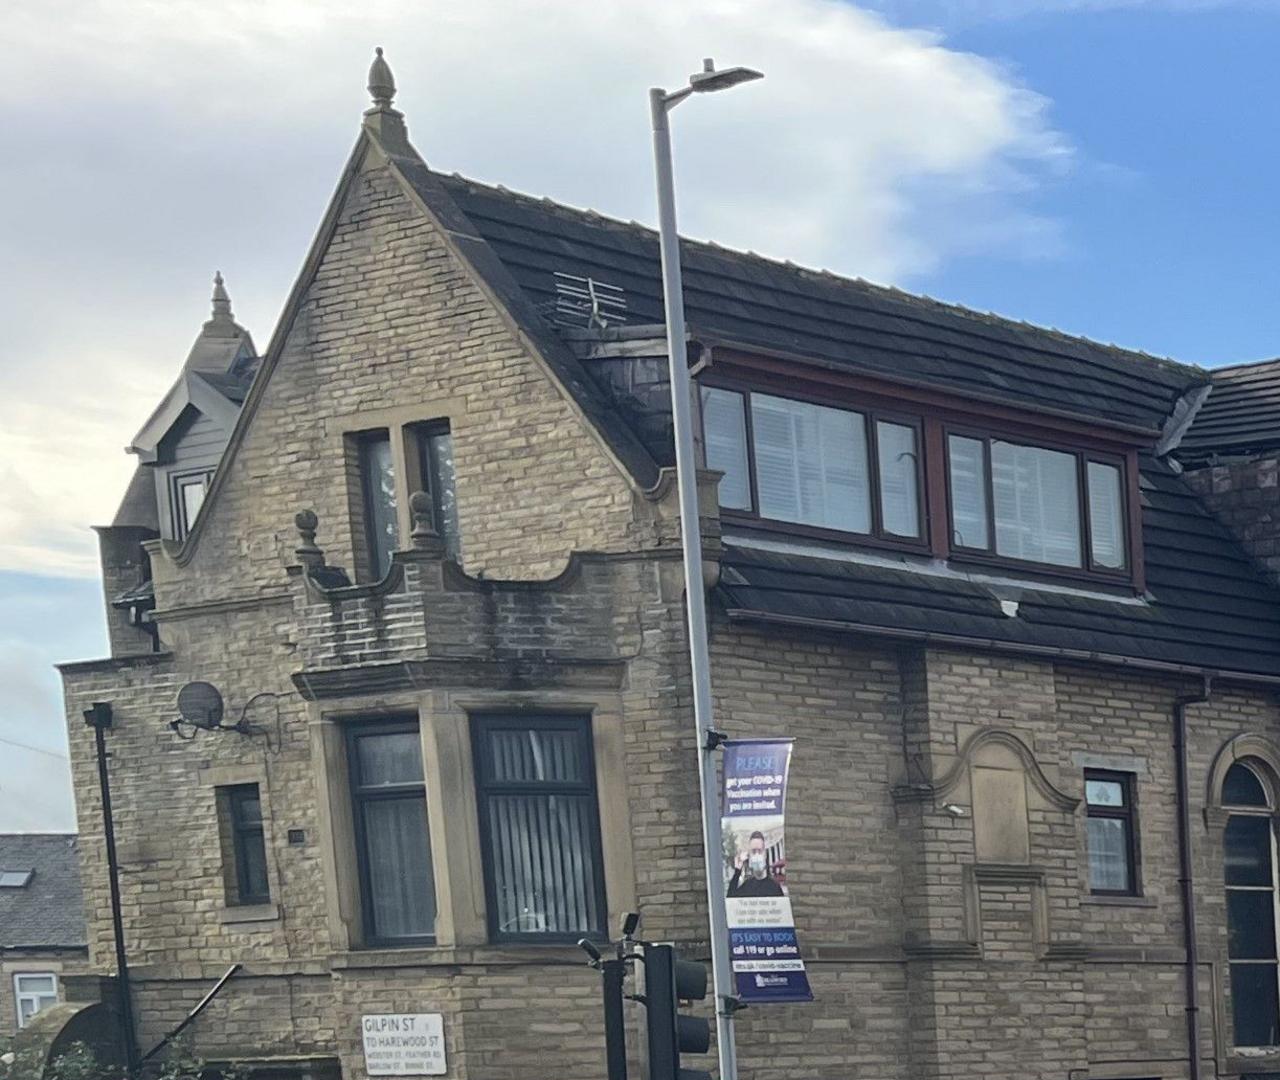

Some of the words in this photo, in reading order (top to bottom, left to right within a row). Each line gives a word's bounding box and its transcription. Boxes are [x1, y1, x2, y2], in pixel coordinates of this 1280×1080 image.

[365, 1018, 400, 1032] GILPIN
[402, 1017, 416, 1031] ST
[366, 1036, 376, 1048] TO
